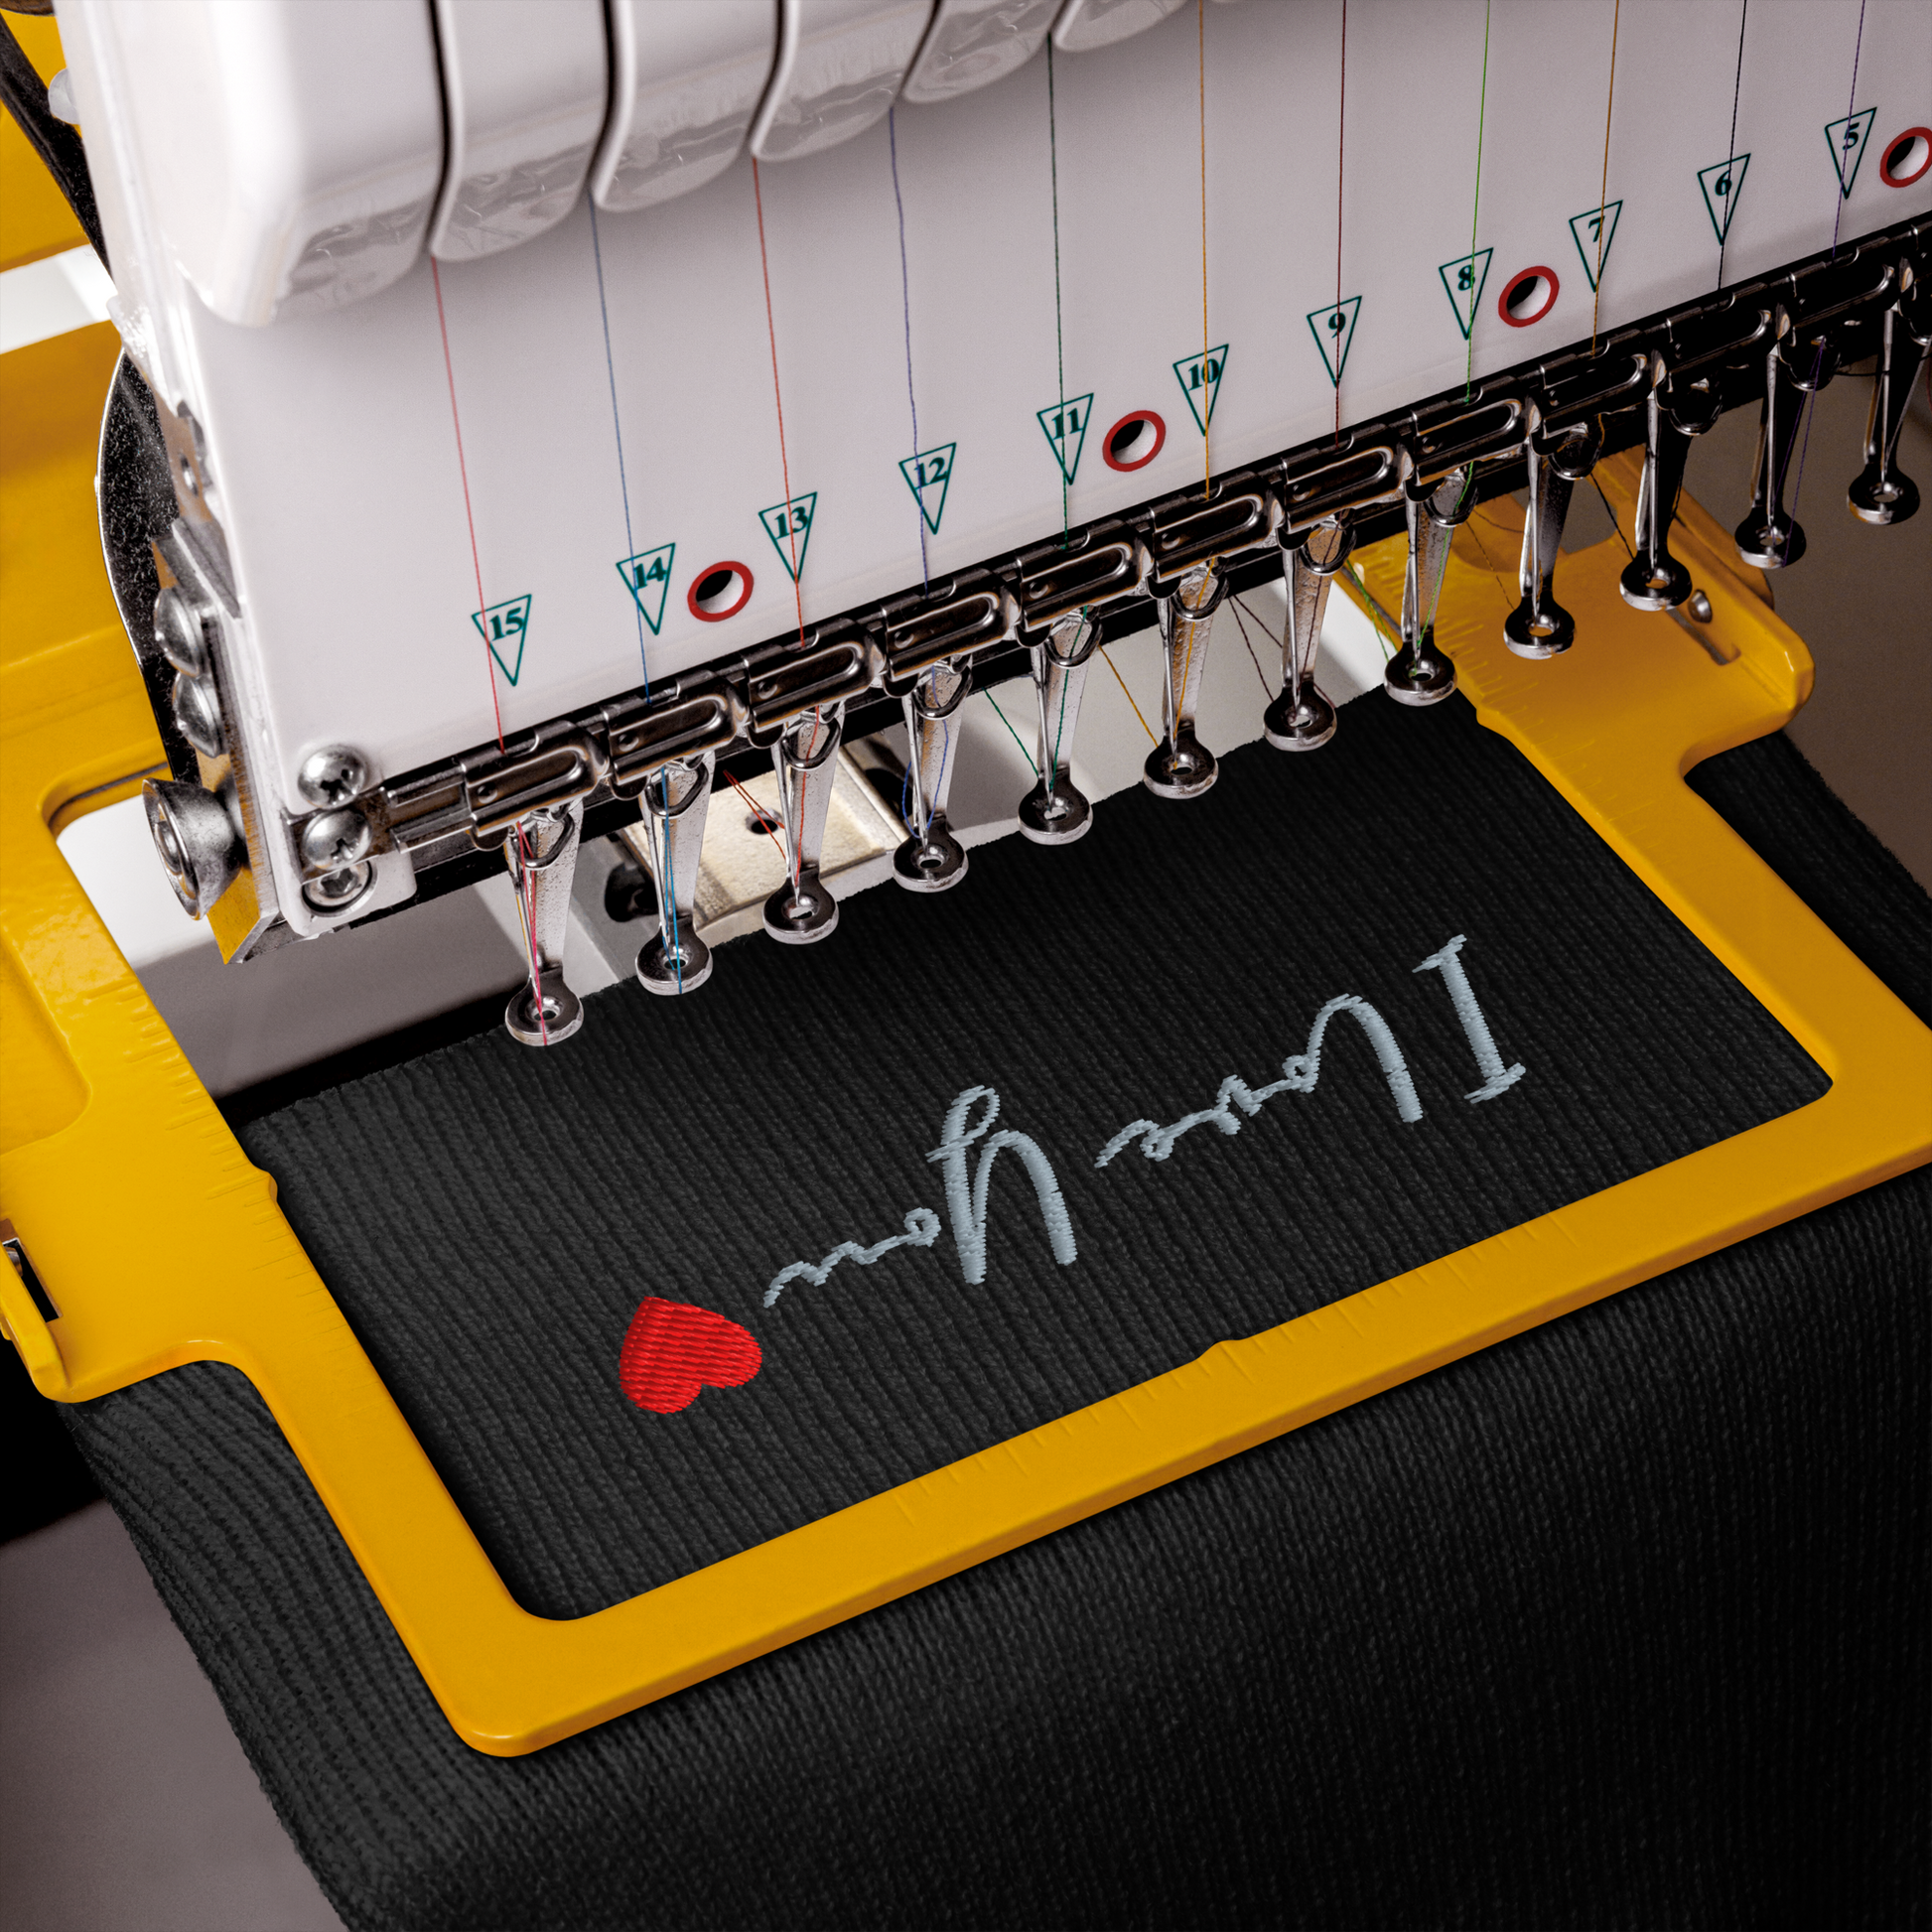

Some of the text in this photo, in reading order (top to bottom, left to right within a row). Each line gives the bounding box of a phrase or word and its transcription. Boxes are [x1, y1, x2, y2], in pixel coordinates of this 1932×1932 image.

[1842, 122, 1860, 150] 5
[1715, 169, 1731, 197] 6
[1587, 215, 1605, 243] 7
[1457, 264, 1476, 291] 8
[1328, 312, 1346, 339] 9
[1187, 358, 1220, 391] 10
[1051, 408, 1083, 440] 11
[914, 457, 948, 489] 12
[774, 506, 808, 539] 13
[633, 556, 668, 590] 14
[489, 607, 524, 641] 15
[763, 934, 1527, 1308] I Love You
